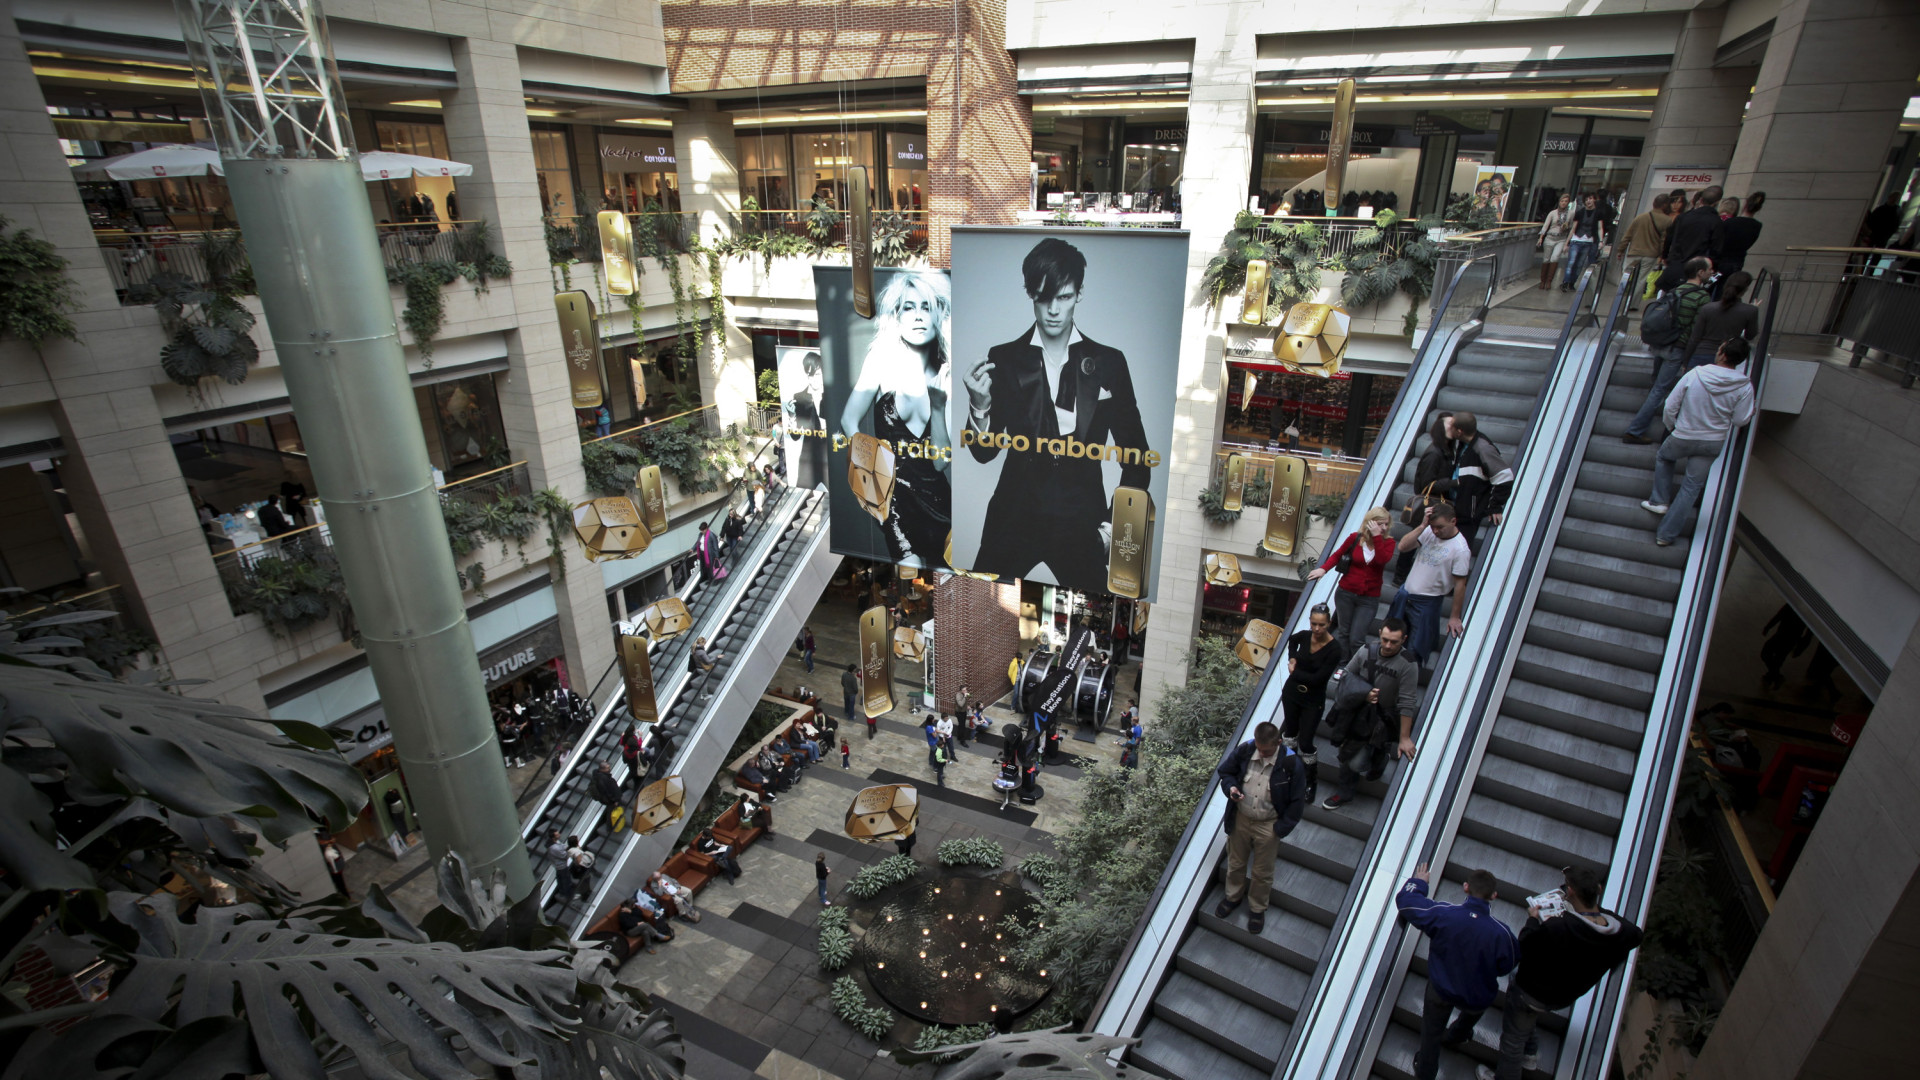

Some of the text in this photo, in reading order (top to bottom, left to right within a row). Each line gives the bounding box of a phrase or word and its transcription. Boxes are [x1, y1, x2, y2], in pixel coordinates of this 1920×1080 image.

[960, 429, 1162, 468] paco rabanne
[1069, 653, 1081, 671] Move
[1046, 696, 1062, 714] Move
